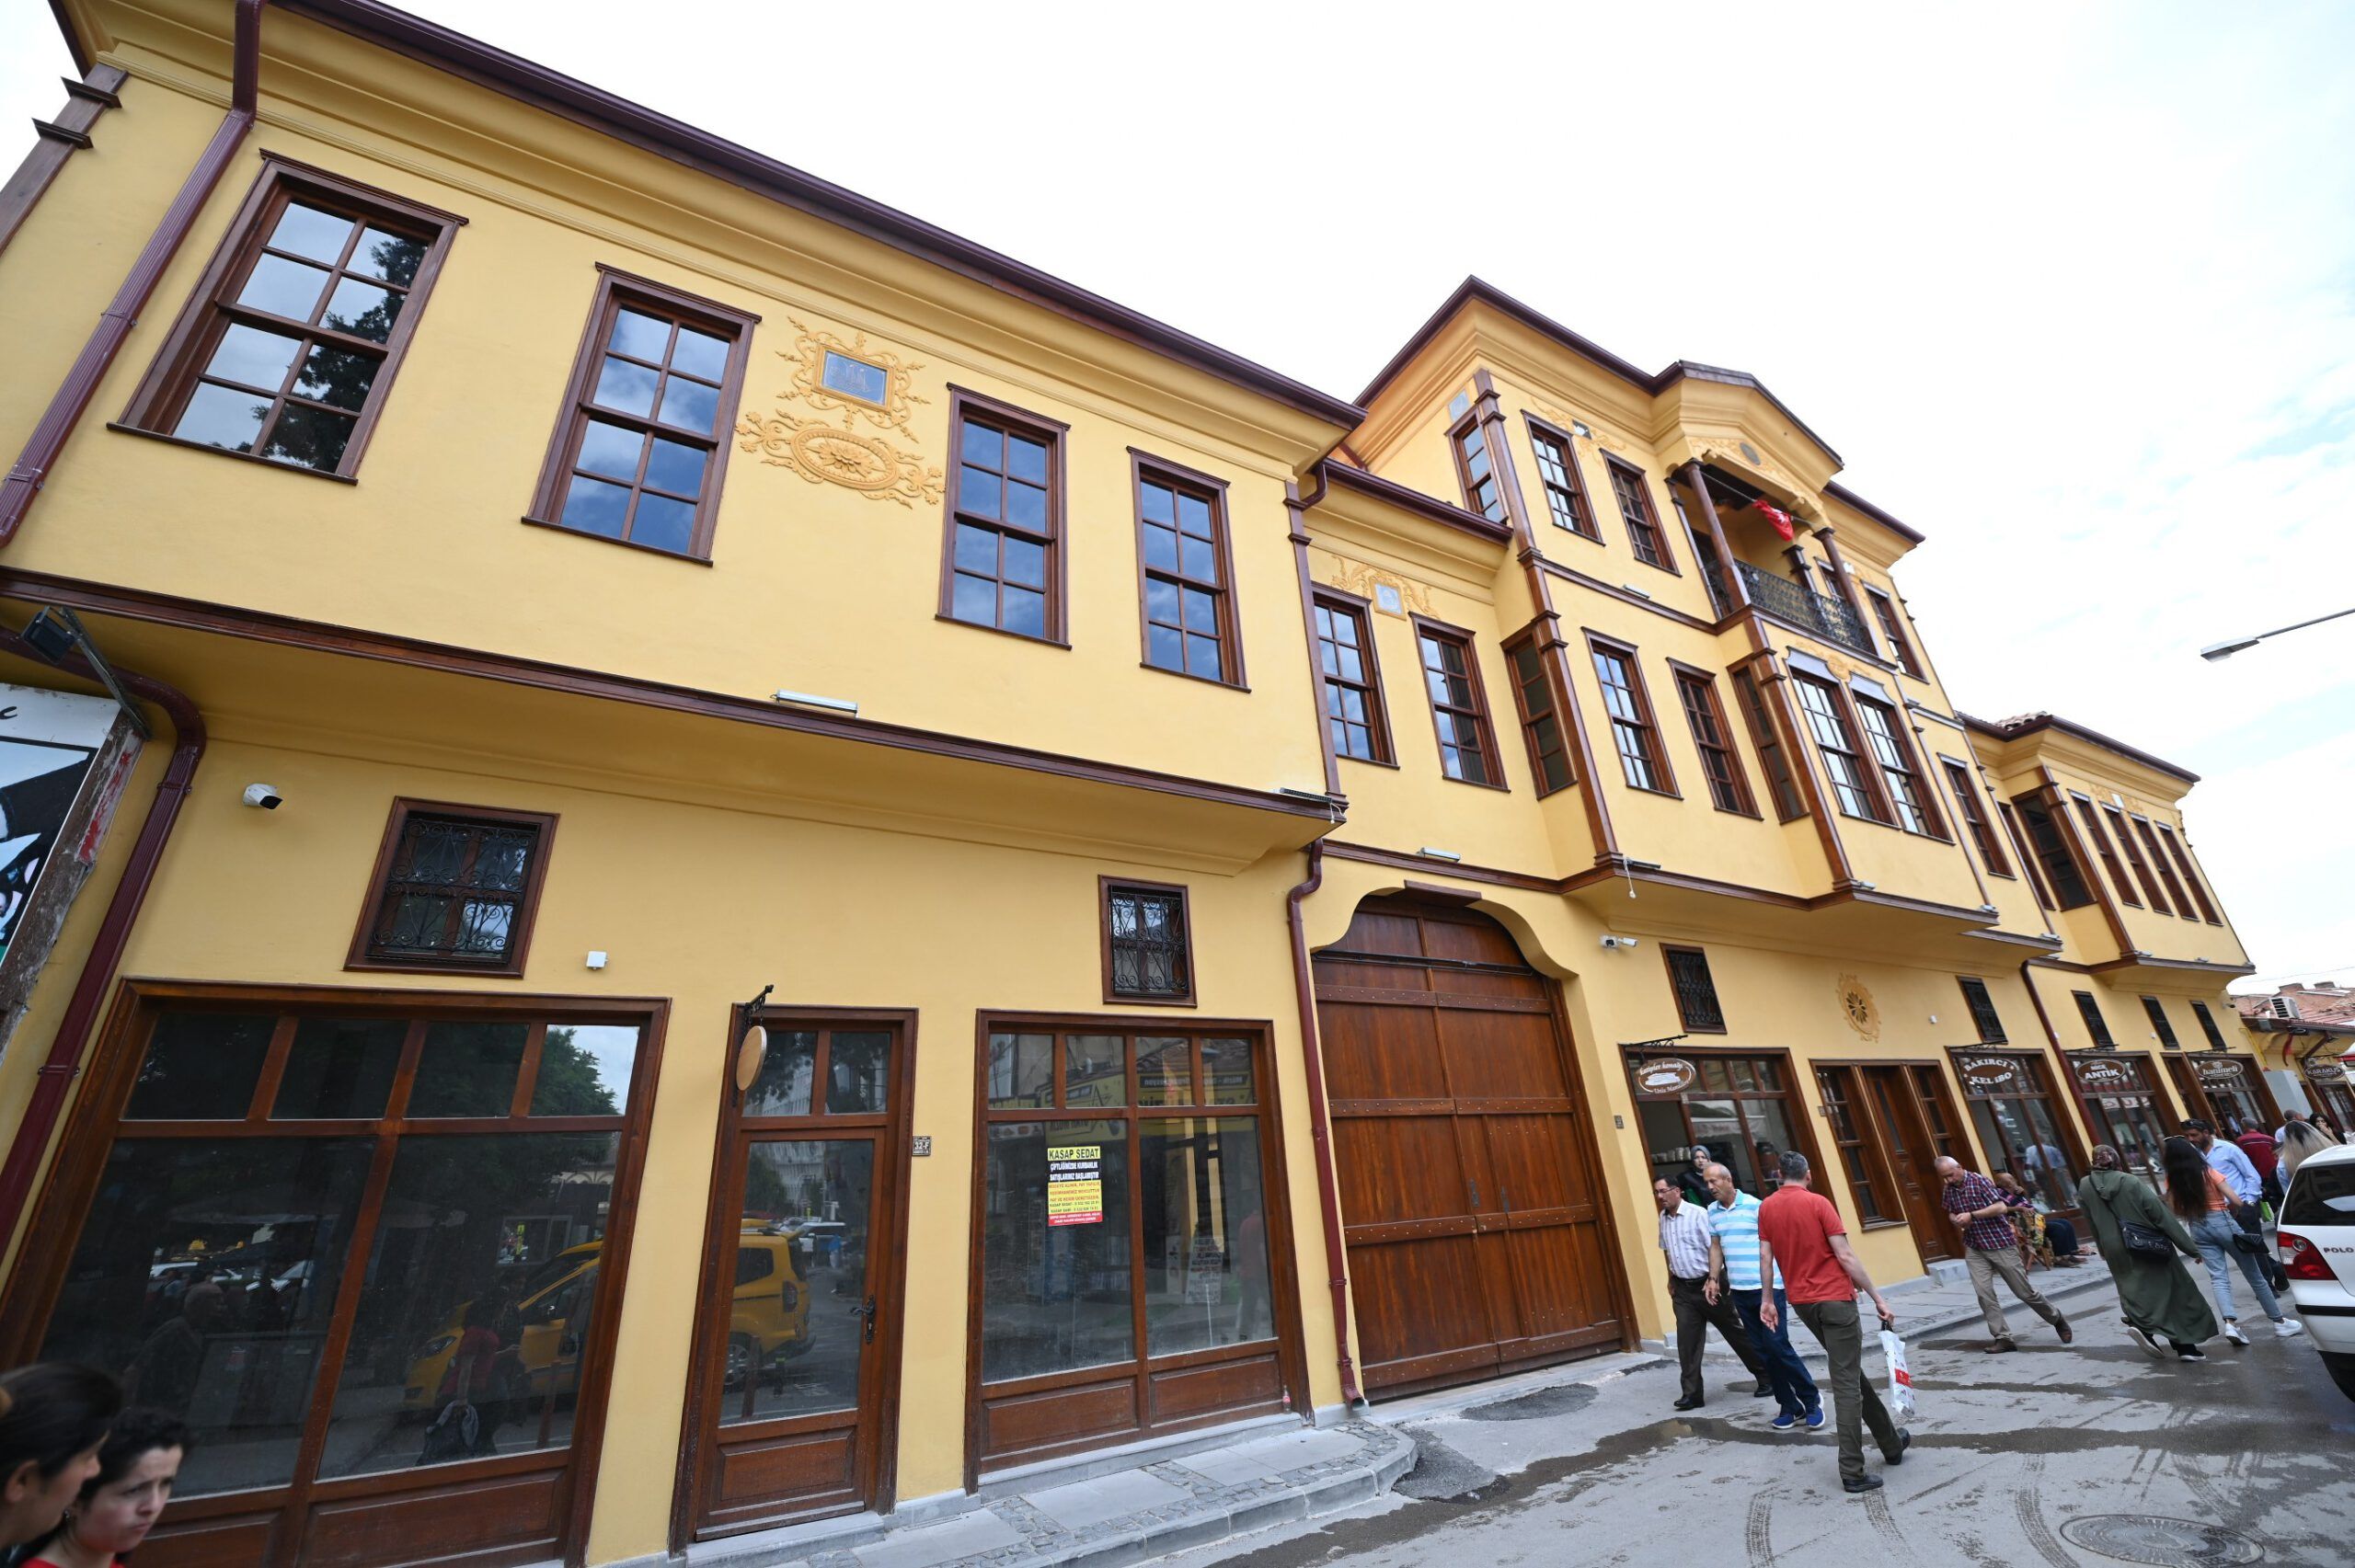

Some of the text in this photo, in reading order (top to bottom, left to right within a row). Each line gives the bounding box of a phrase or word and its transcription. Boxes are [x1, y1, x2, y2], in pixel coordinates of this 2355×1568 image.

[1964, 1059, 2007, 1070] BAKIRCI
[914, 1141, 929, 1150] 32-F
[1049, 1149, 1098, 1159] KASAP SEDAT
